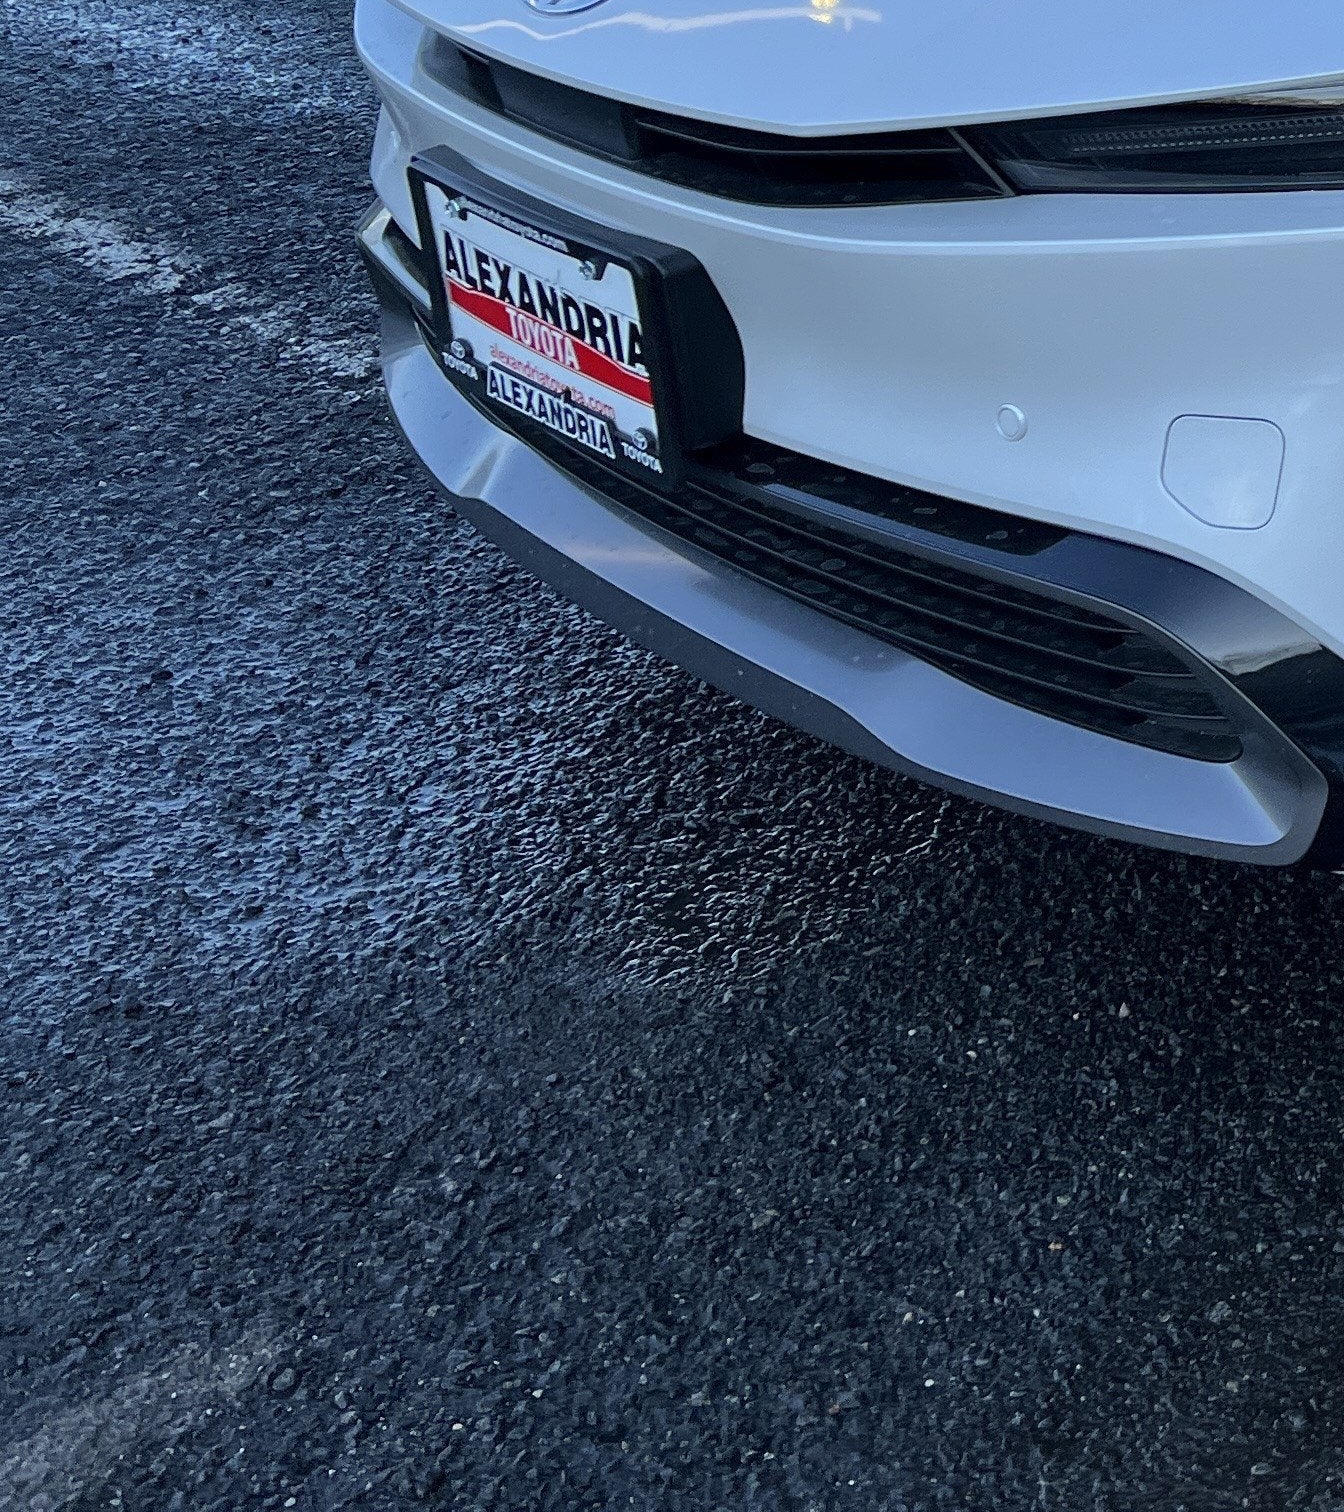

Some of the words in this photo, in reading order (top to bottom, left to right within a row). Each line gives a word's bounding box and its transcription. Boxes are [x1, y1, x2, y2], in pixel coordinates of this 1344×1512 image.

[445, 229, 650, 378] ALEXANDRIA
[441, 351, 479, 381] TOYOTA
[504, 307, 580, 371] TOYOTA
[488, 367, 615, 459] ALEXANDRIA
[620, 441, 664, 475] TOYOTA
